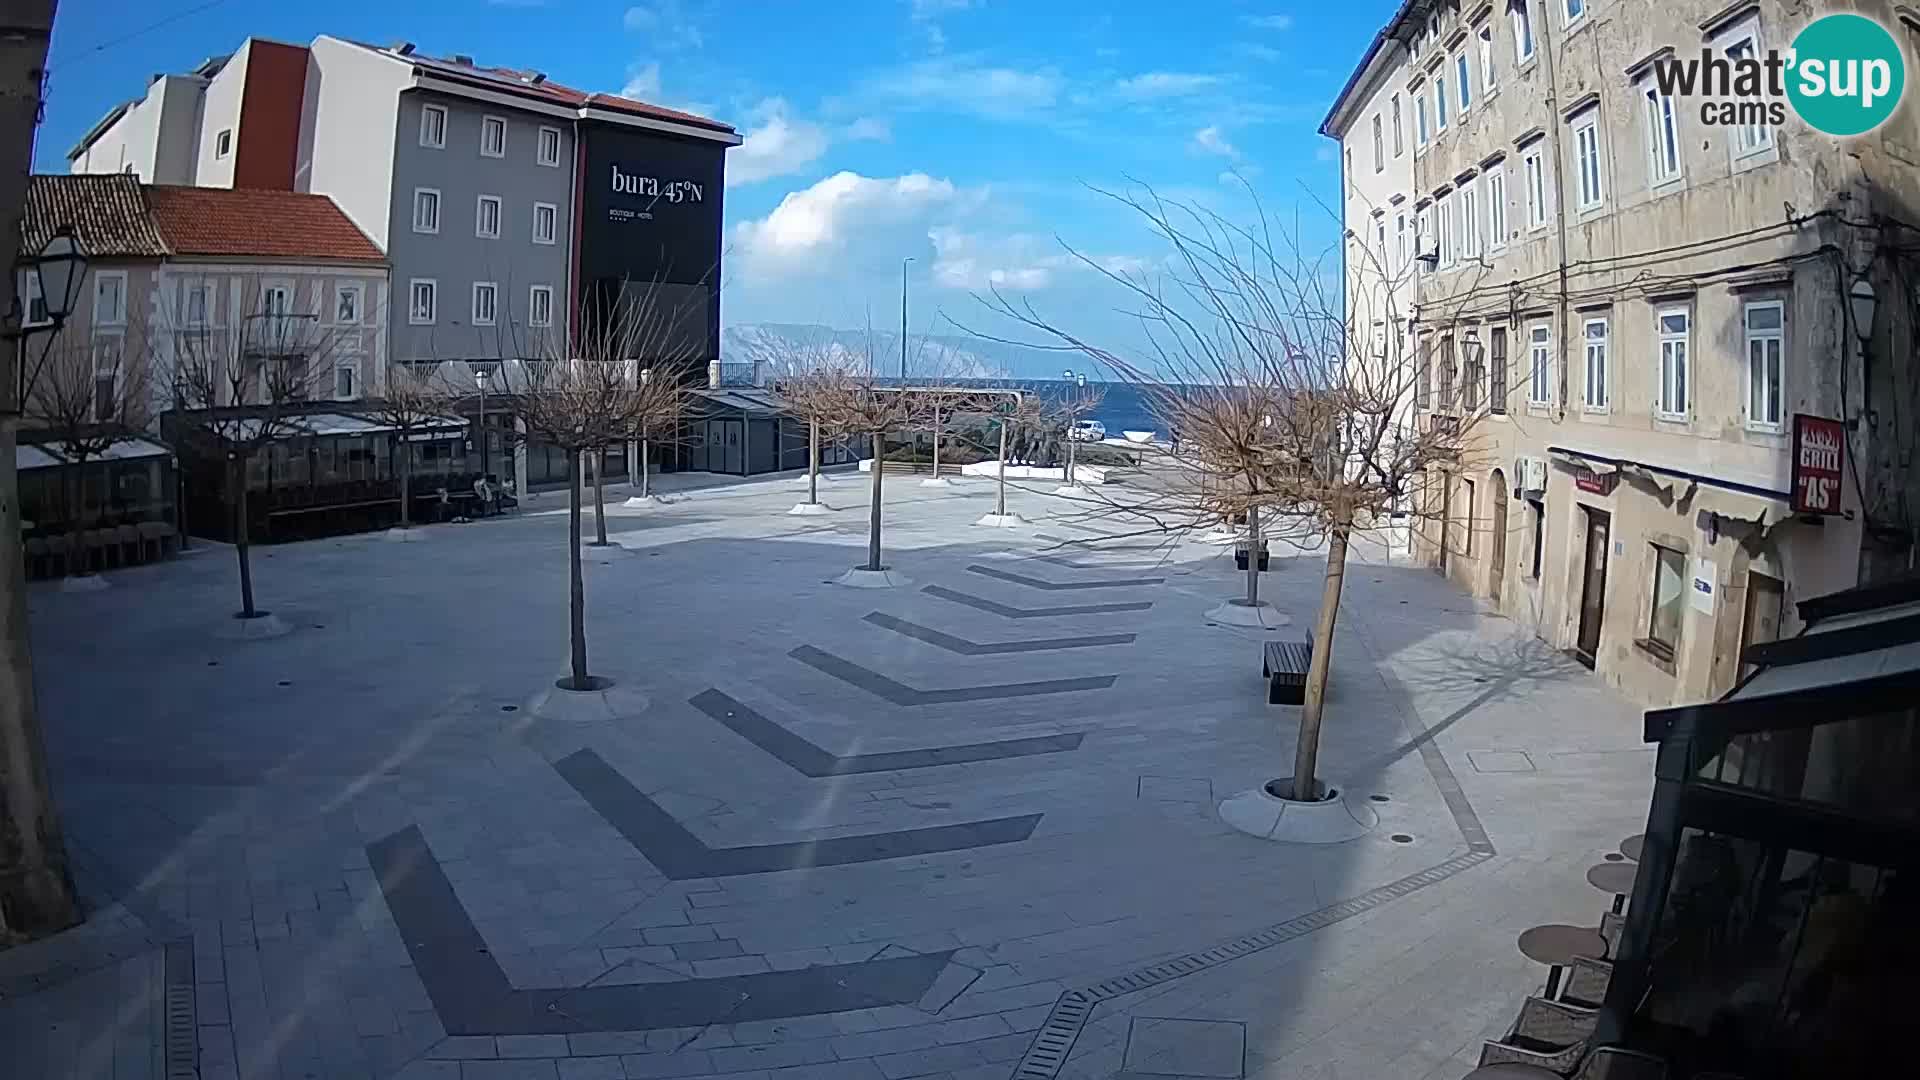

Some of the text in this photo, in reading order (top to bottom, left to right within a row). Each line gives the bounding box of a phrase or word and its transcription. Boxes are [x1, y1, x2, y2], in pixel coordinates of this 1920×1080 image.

[612, 165, 658, 196] bura
[609, 209, 635, 217] BOUTIQUE
[1800, 447, 1840, 472] GRILL
